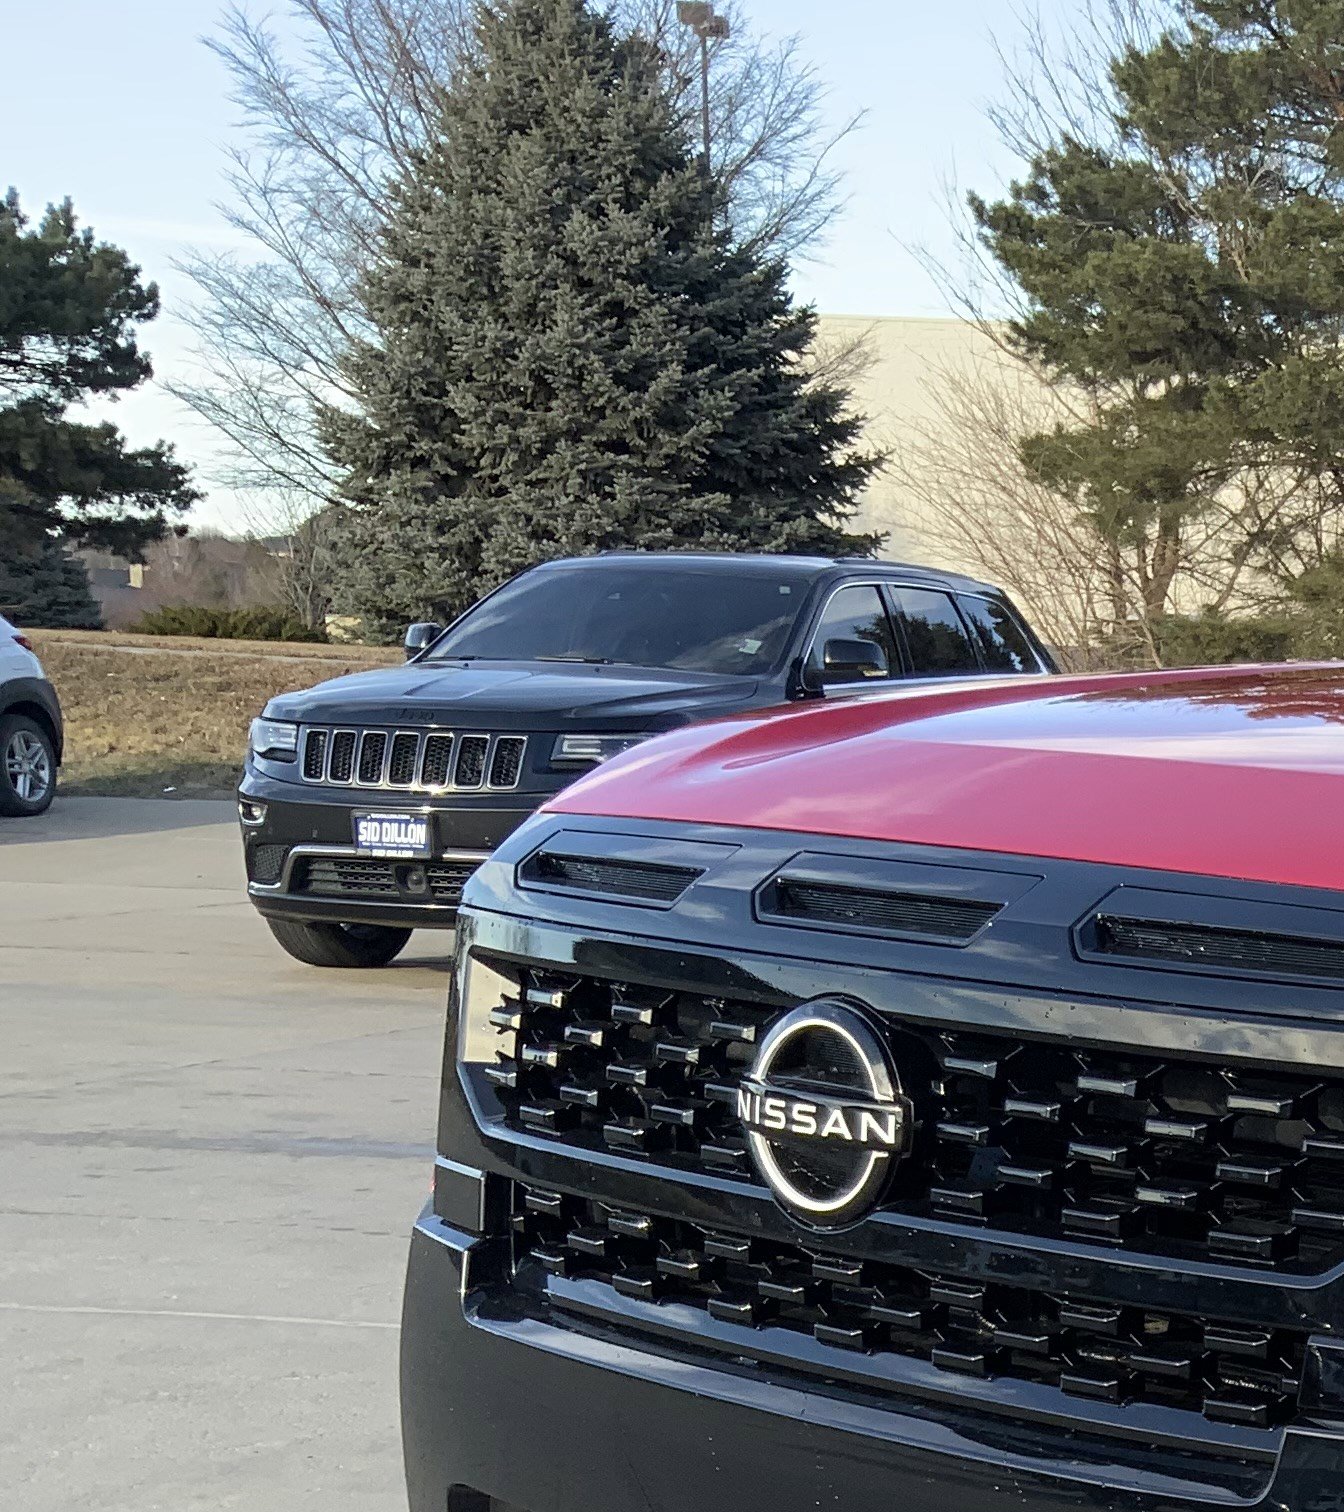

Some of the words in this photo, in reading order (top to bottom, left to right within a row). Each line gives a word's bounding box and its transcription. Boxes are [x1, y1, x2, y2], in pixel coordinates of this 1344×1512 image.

[358, 821, 380, 842] SID
[381, 822, 426, 844] DILLON
[737, 1089, 897, 1145] NISSAN
